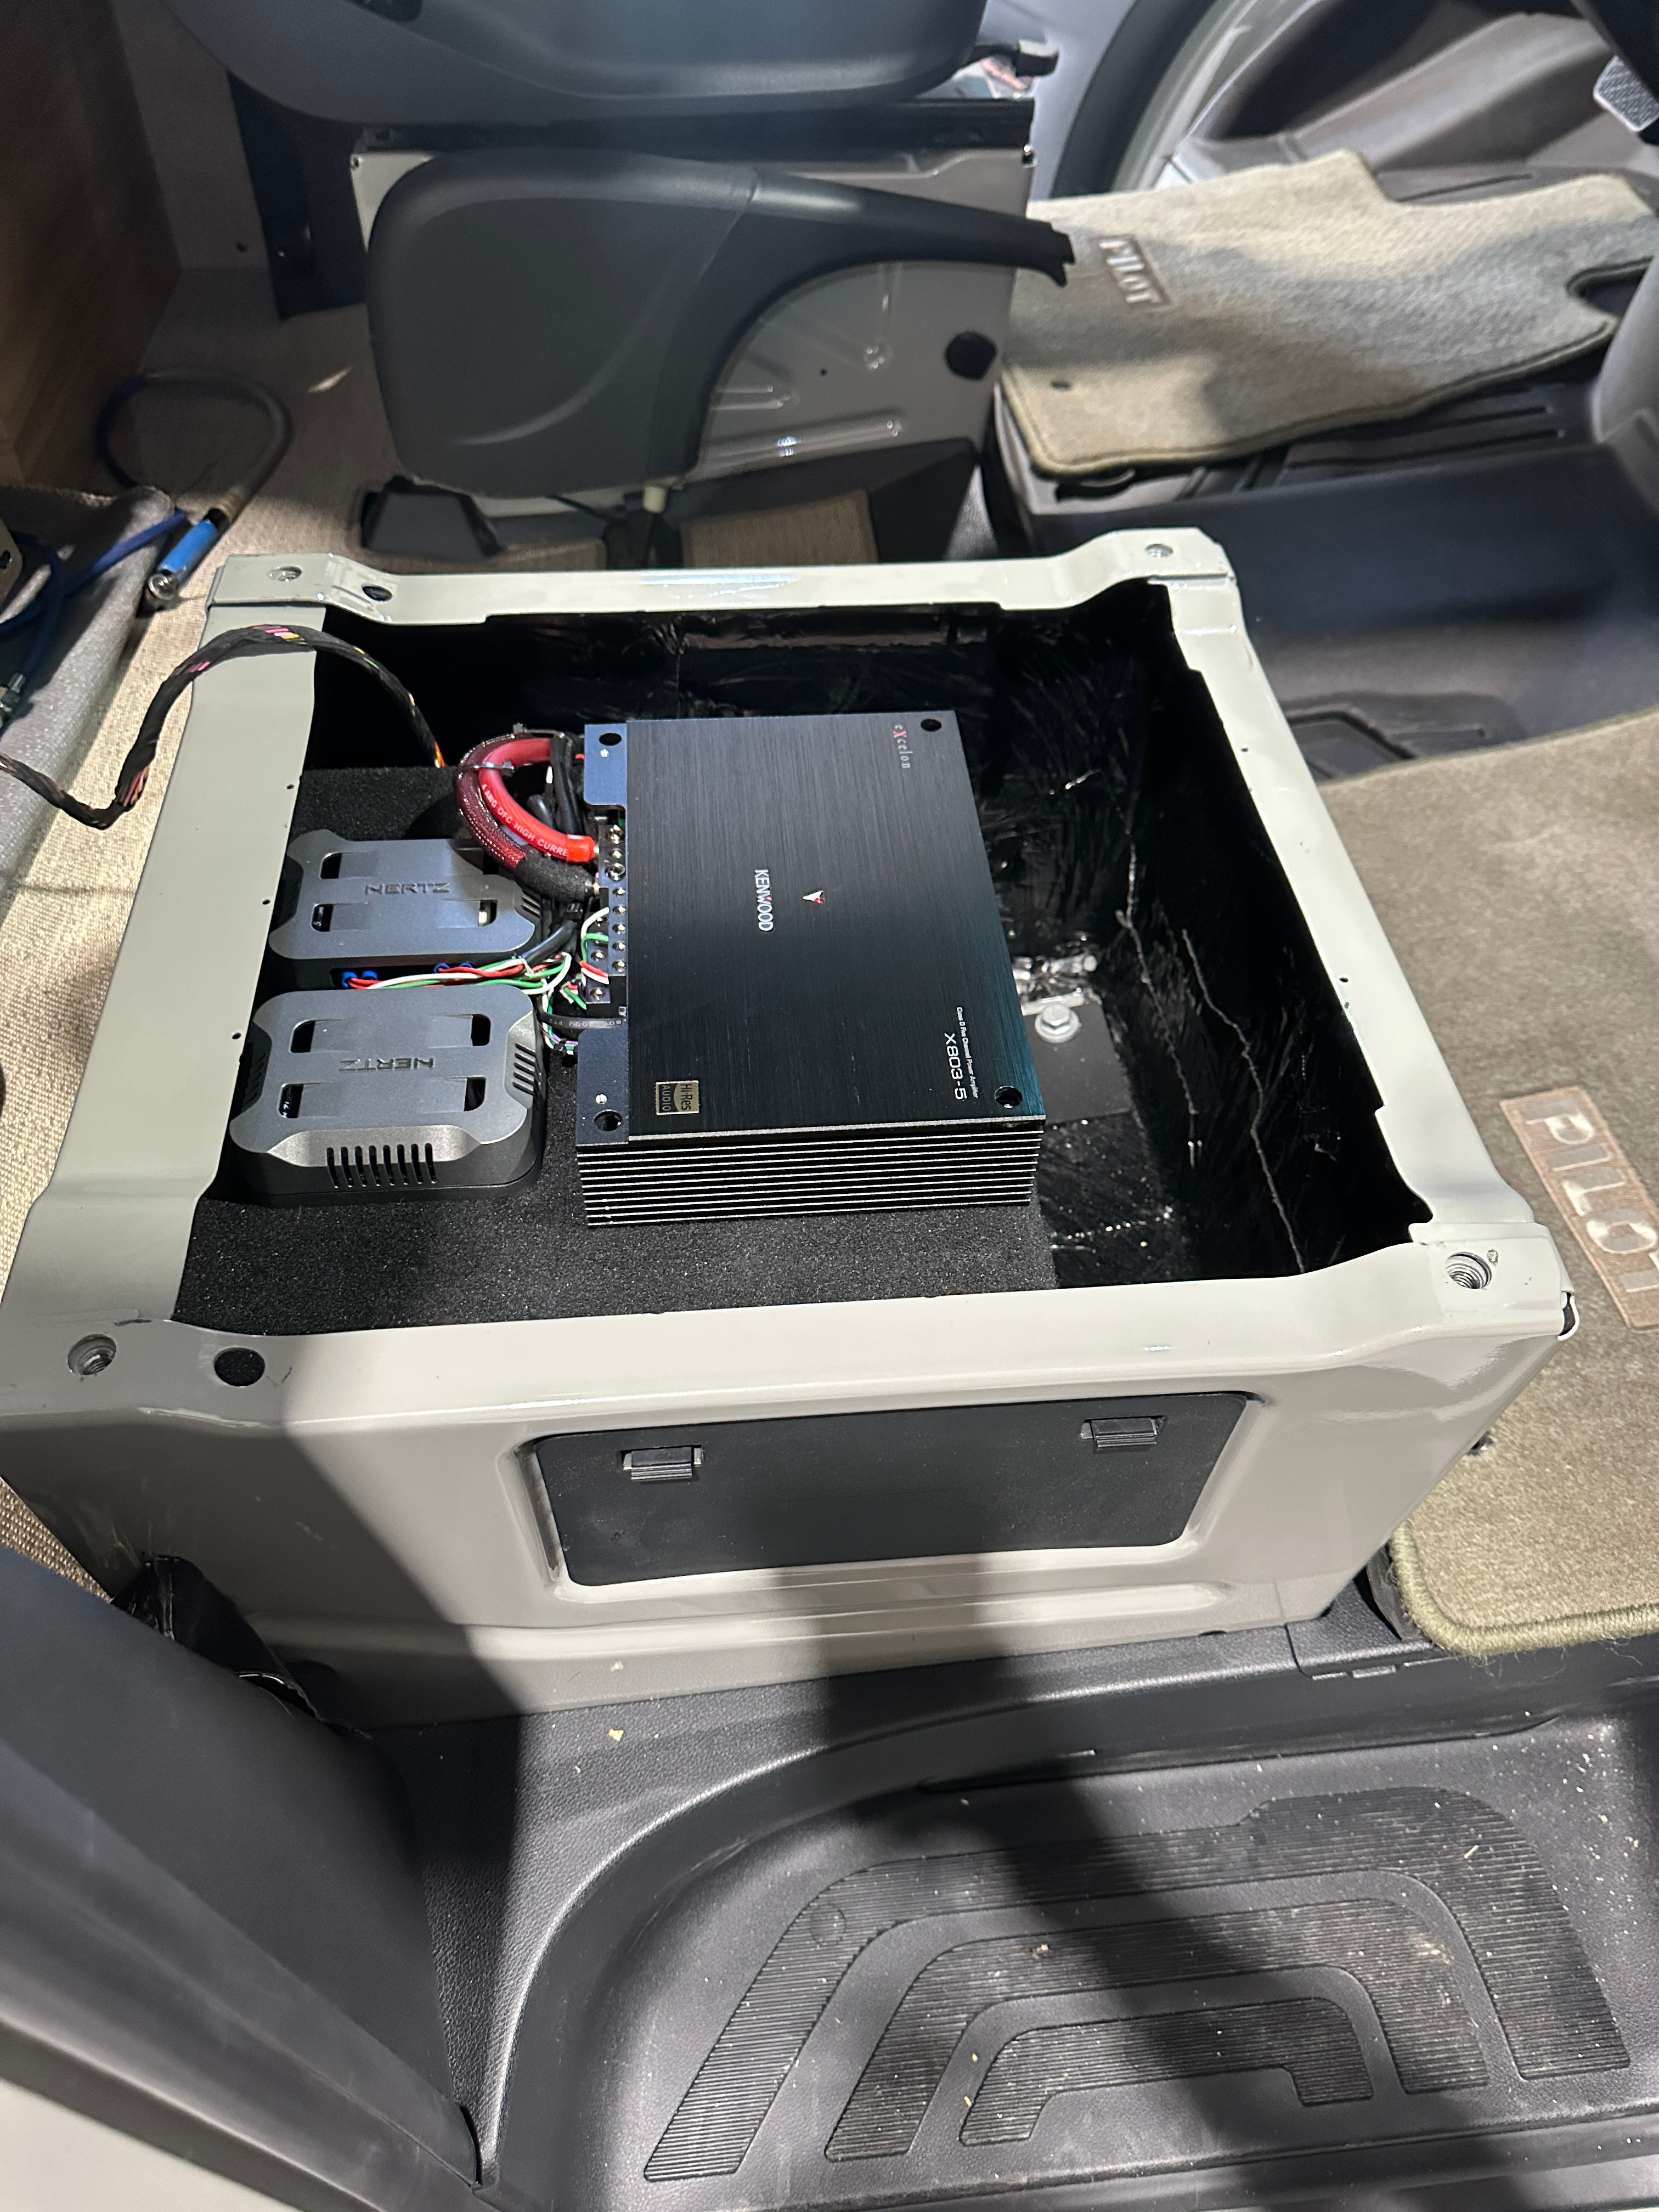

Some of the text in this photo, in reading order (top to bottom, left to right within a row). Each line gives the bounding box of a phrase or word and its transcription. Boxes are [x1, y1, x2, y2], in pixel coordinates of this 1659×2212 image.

[484, 790, 498, 808] AWG
[497, 807, 513, 824] OFC
[514, 822, 536, 842] HIGH
[537, 839, 568, 856] CURRE
[755, 869, 774, 932] KENWOOD
[944, 1032, 967, 1099] X803-5
[662, 1085, 672, 1111] AUDIO
